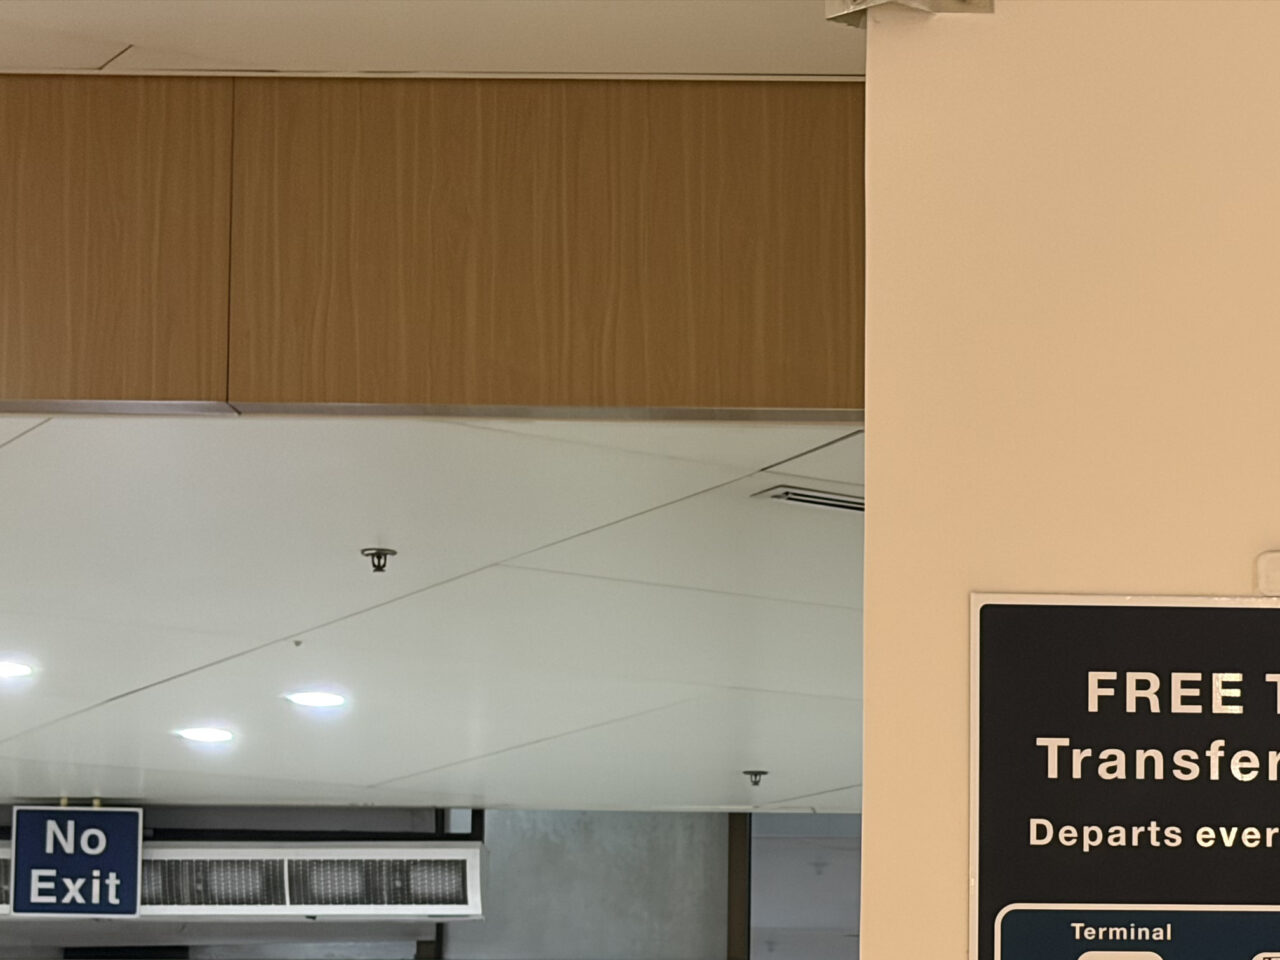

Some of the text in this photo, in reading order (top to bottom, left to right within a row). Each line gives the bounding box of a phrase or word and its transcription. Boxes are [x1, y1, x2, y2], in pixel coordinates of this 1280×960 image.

[1087, 671, 1244, 714] FREE
[45, 820, 107, 856] No
[1029, 819, 1182, 852] Departs
[29, 869, 121, 906] Exit
[1071, 922, 1172, 942] Terminal
